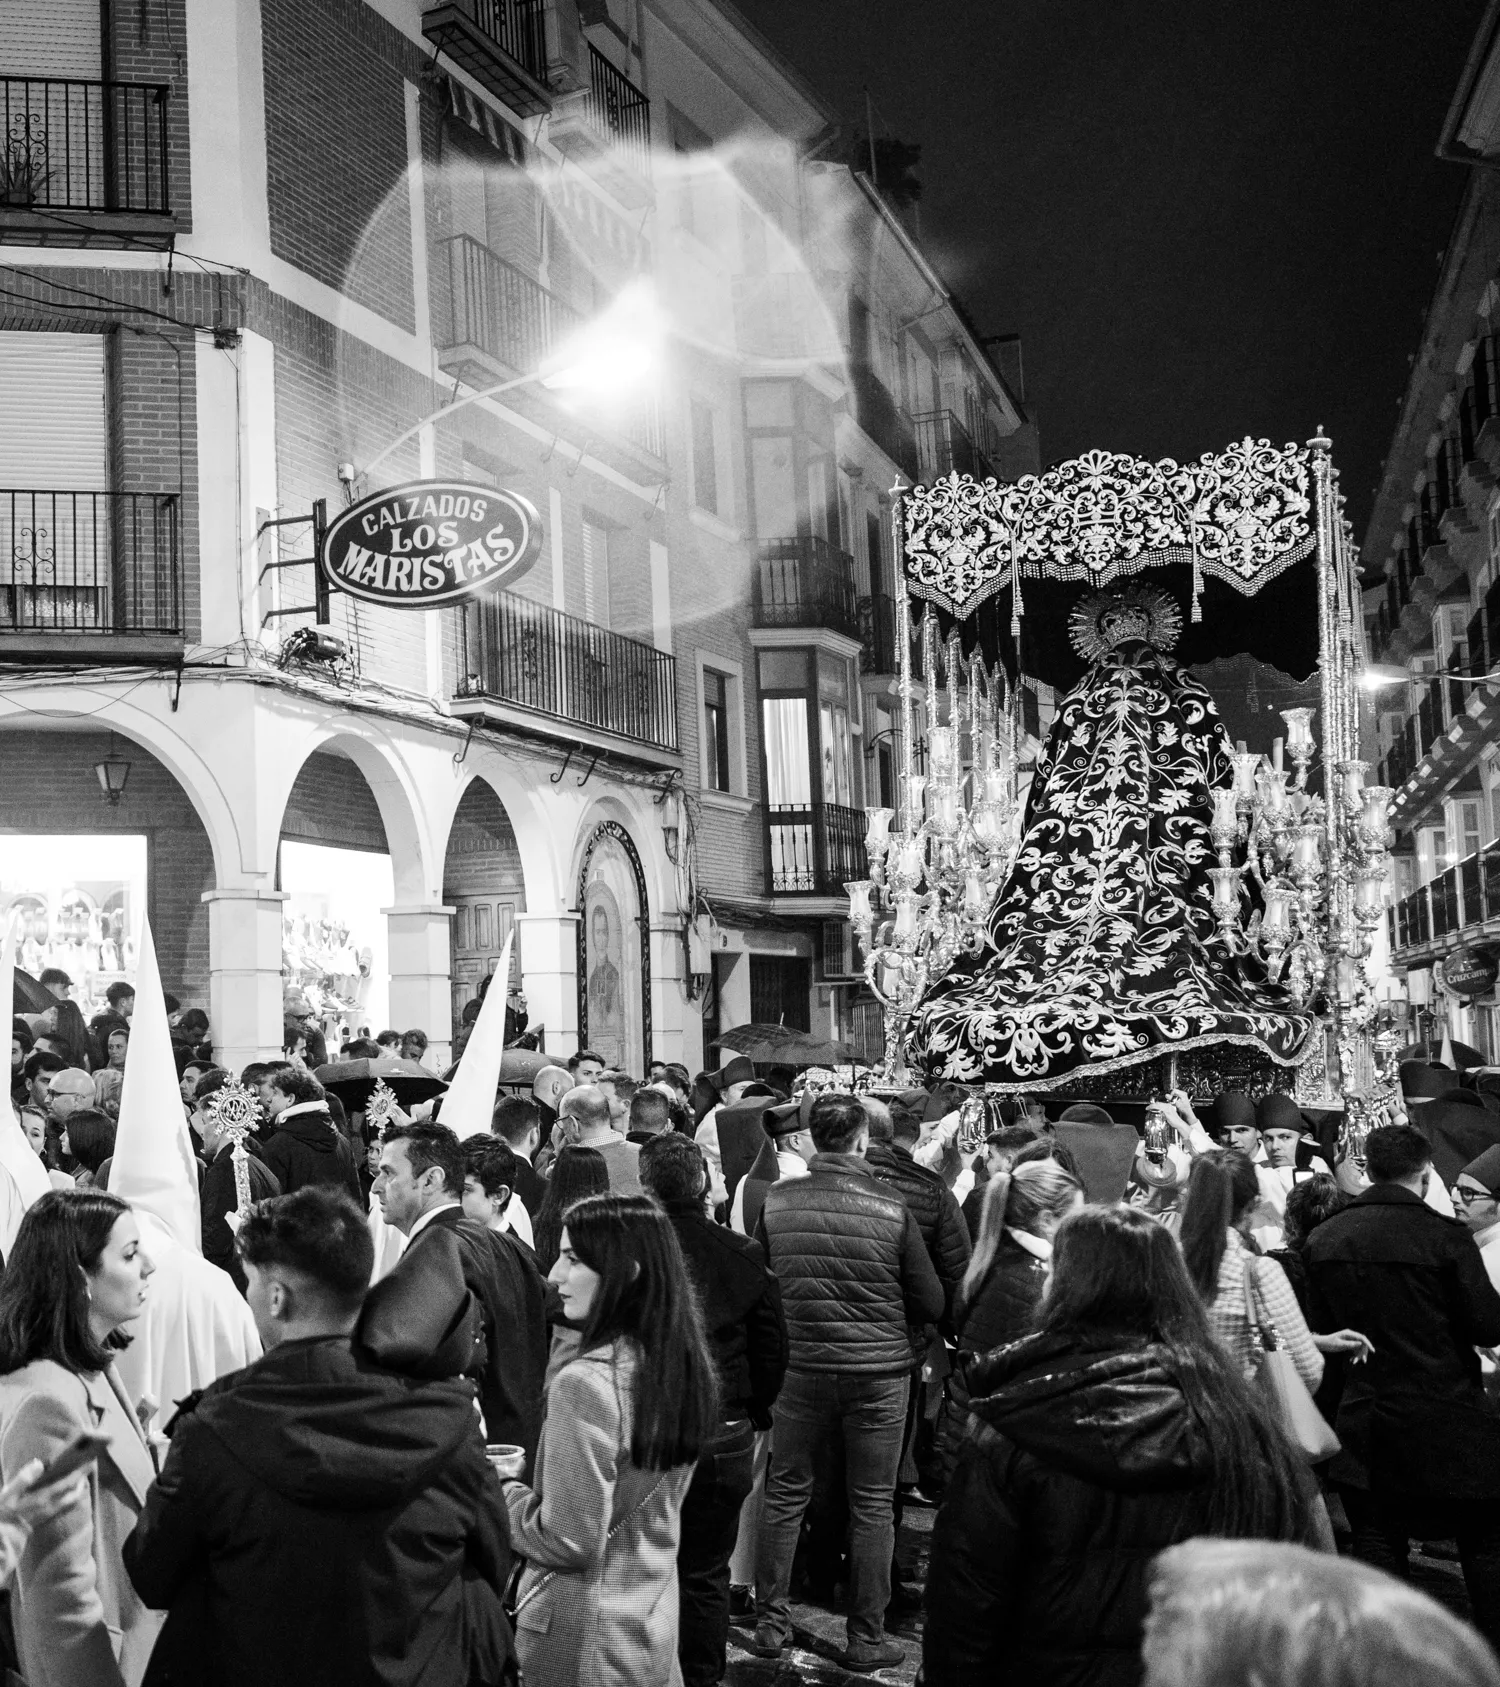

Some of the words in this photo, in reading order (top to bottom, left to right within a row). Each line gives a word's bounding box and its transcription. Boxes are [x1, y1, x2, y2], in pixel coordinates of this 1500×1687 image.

[361, 494, 487, 536] CALZADOS
[390, 521, 459, 553] LOS
[336, 522, 515, 591] MARISTAS
[1447, 967, 1495, 984] Cruzcampo
